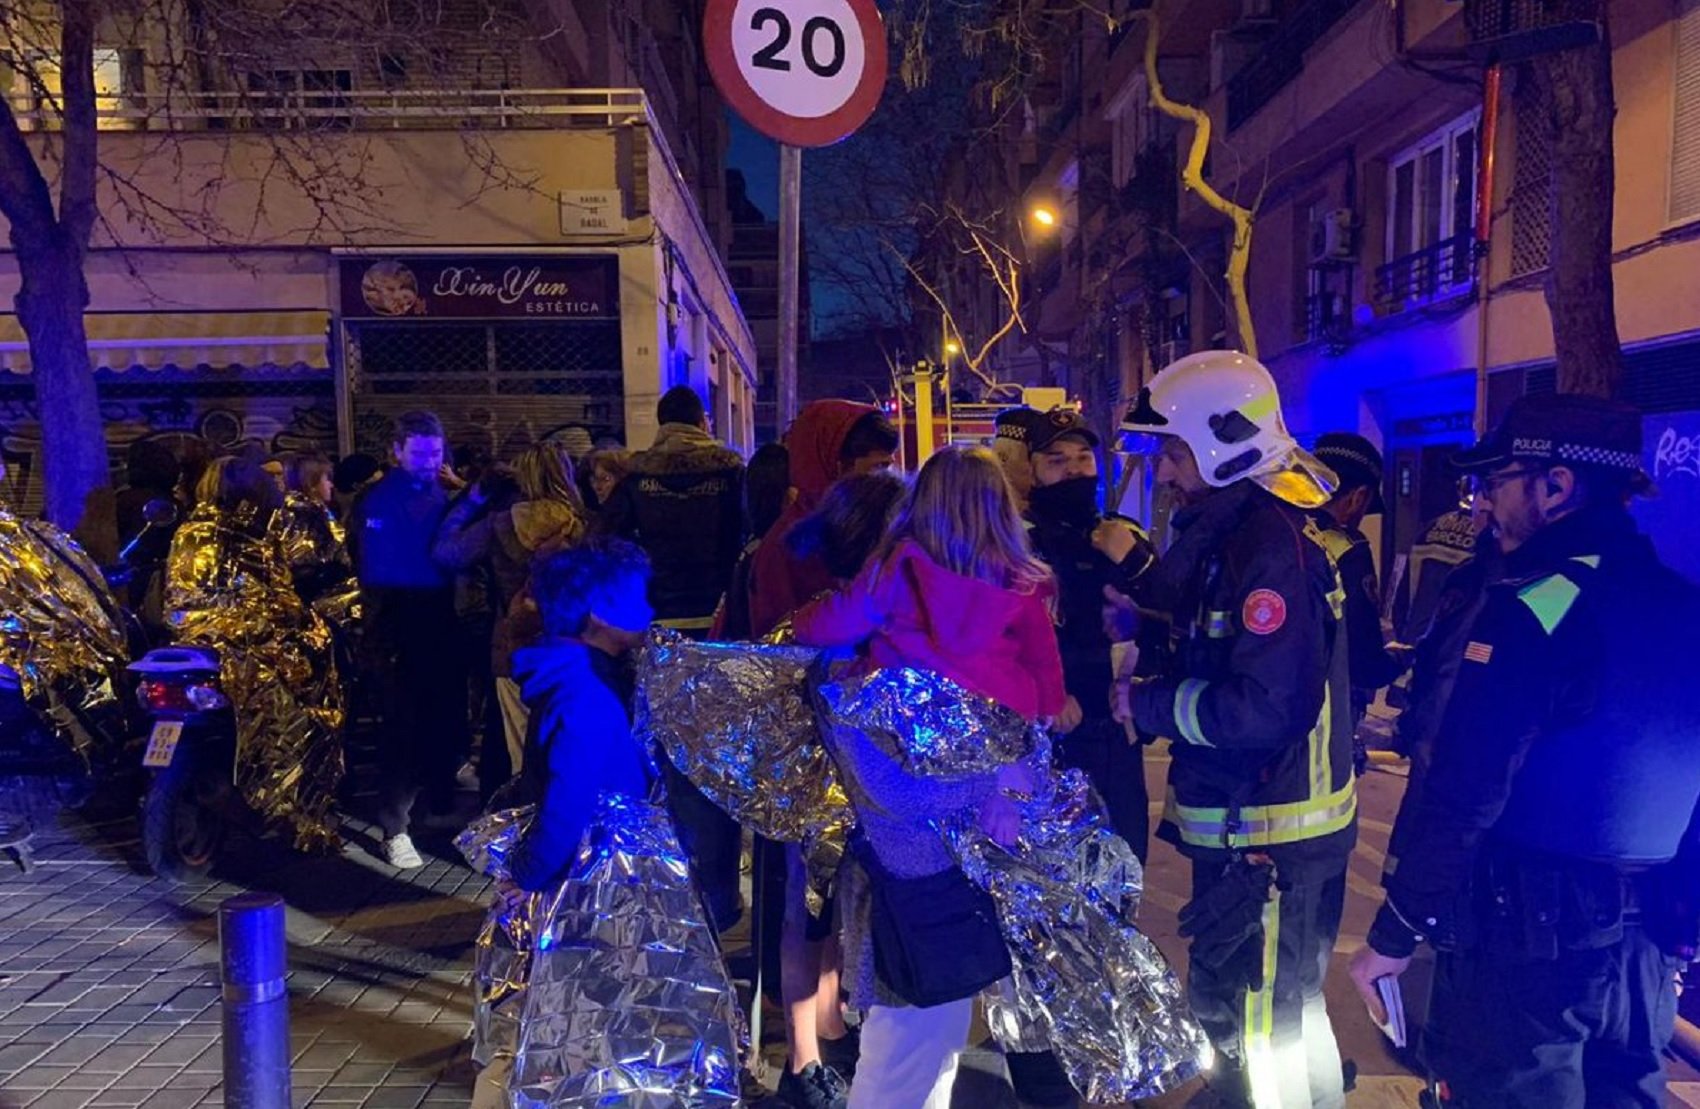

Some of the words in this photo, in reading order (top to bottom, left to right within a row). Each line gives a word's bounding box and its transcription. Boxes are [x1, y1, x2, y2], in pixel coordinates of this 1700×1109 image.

[751, 7, 845, 77] 20
[497, 265, 568, 304] Yun
[525, 300, 600, 313] ESTÉTICA
